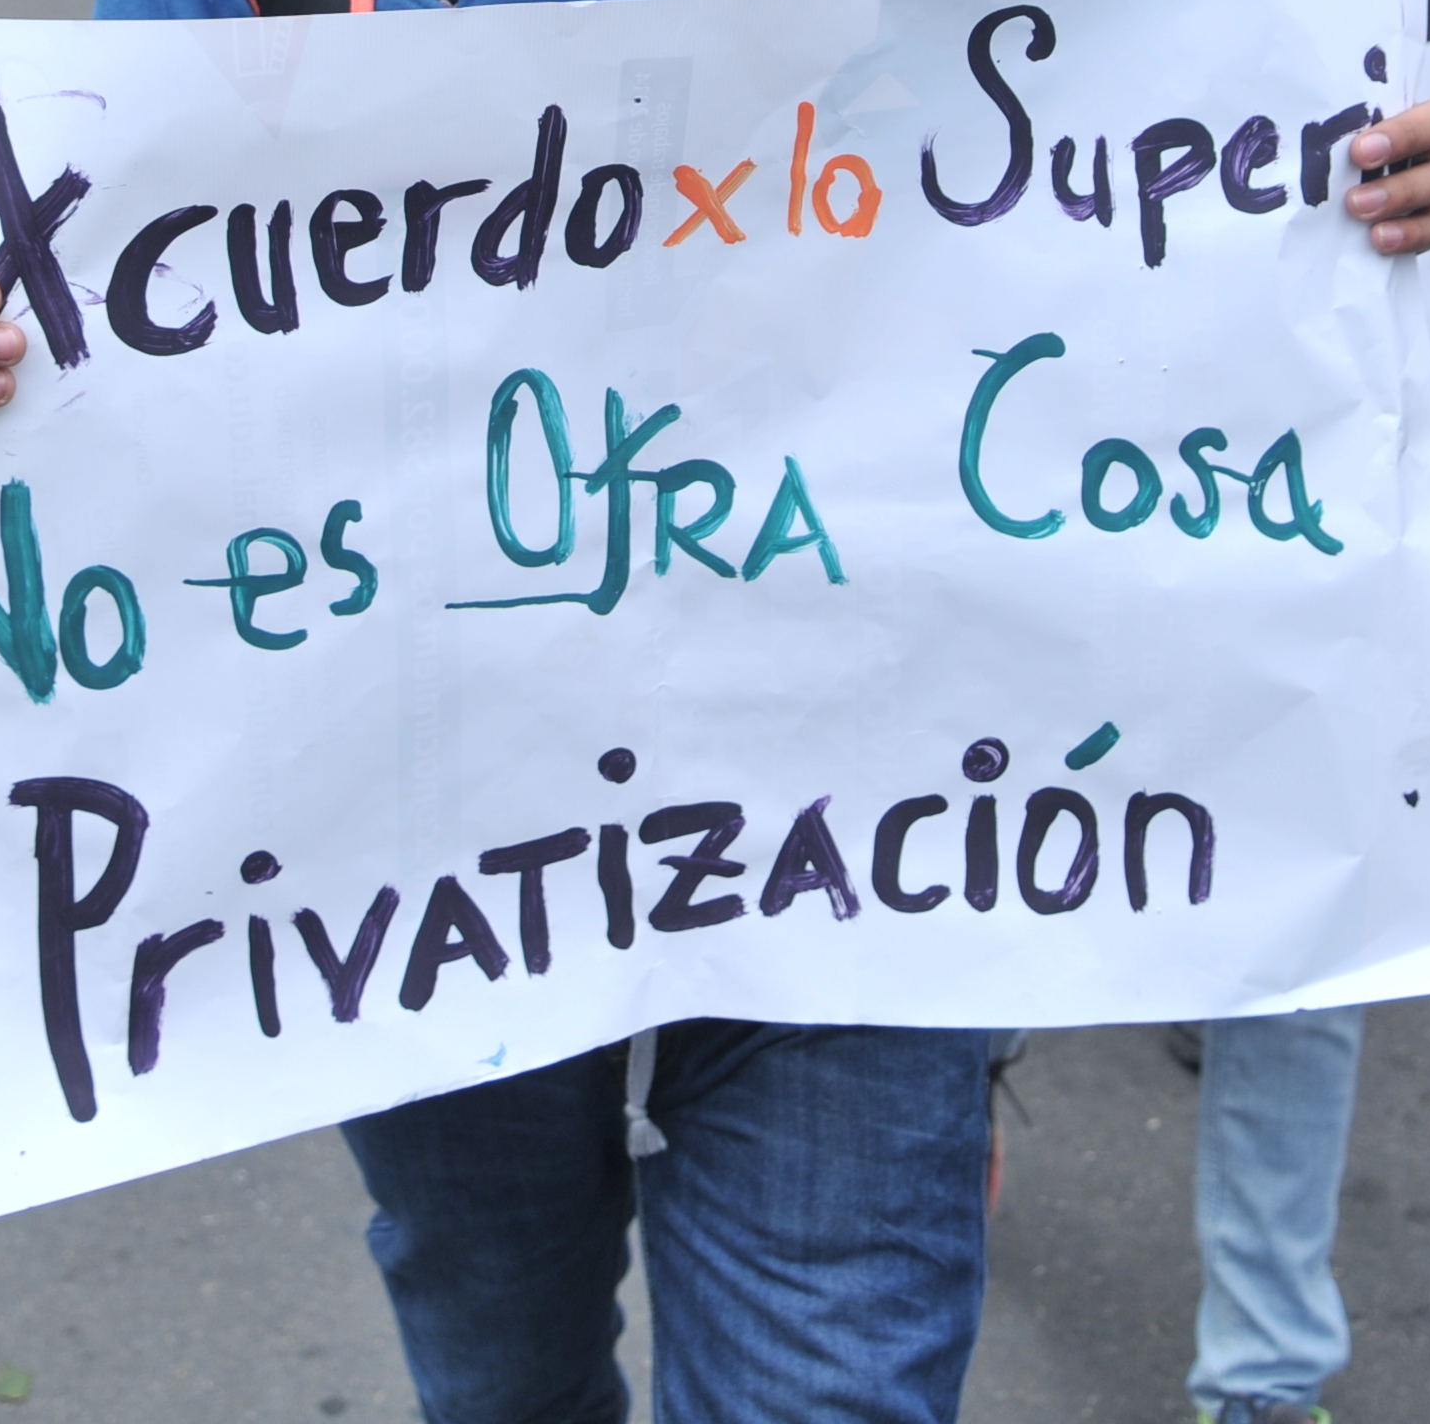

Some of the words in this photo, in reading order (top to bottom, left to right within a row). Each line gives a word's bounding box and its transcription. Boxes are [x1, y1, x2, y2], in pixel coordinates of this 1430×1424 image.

[661, 156, 758, 249] x
[786, 101, 883, 239] lo
[919, 4, 1409, 269] Superi
[183, 499, 379, 651] es
[958, 331, 1345, 556] Cosa
